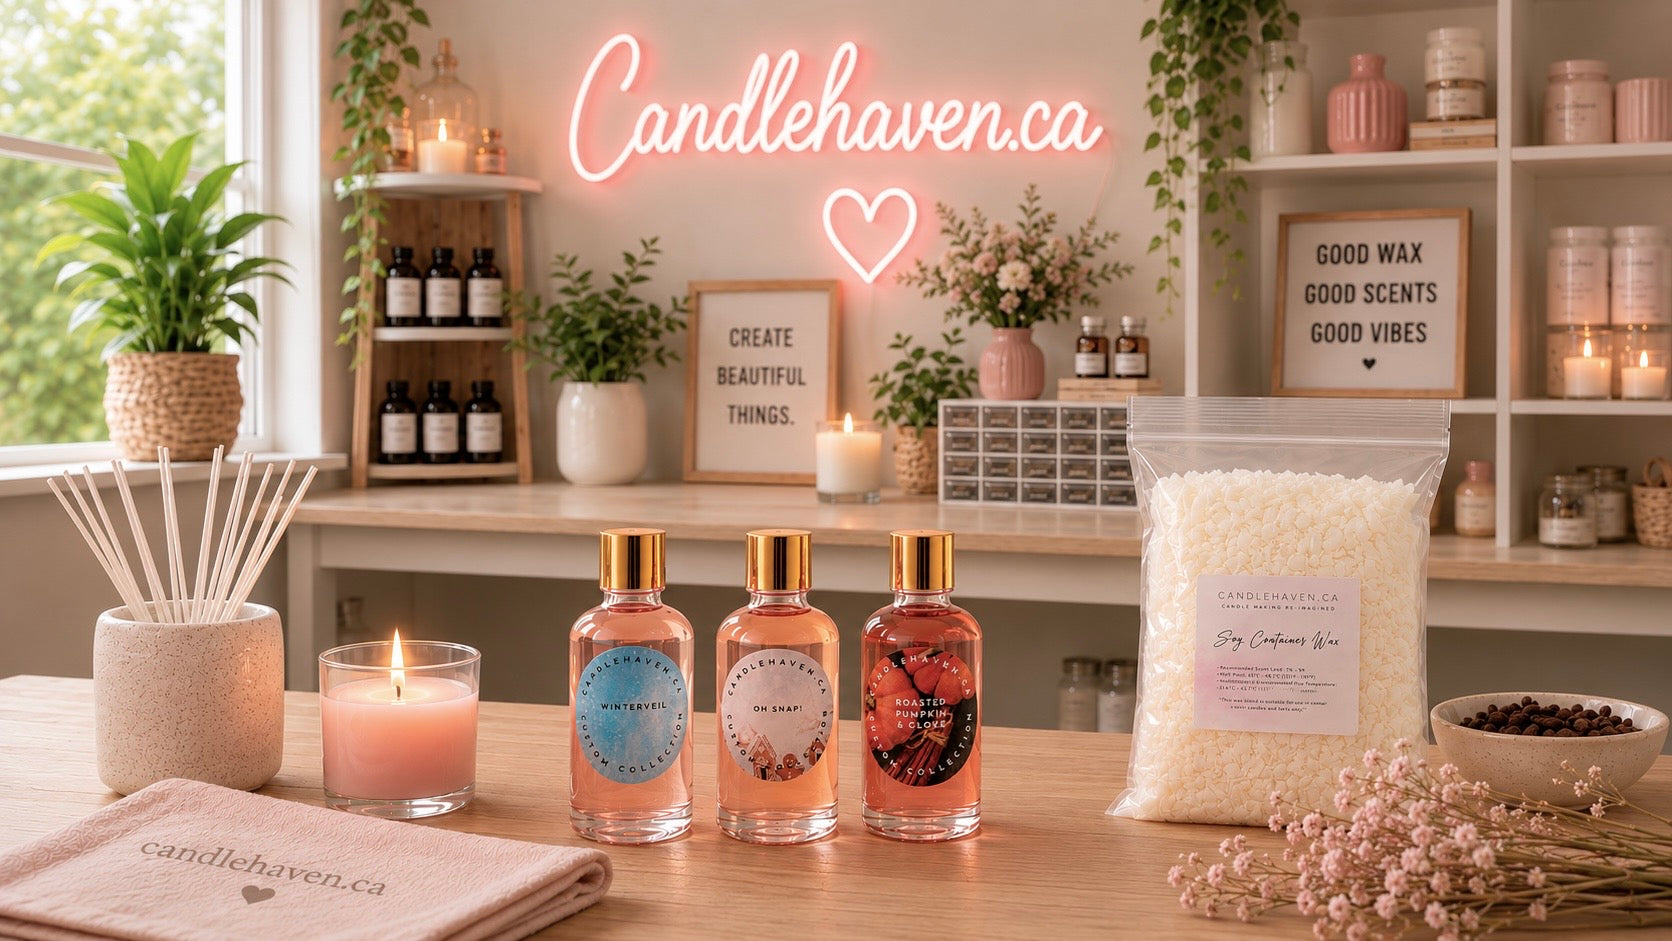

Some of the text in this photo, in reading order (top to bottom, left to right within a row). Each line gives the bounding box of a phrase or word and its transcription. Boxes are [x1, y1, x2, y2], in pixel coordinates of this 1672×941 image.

[568, 33, 1103, 182] Candlehaven.ca
[1317, 242, 1423, 265] GOOD WAX
[1304, 282, 1437, 304] GOOD SCENTS
[729, 327, 793, 347] CREATE
[1311, 322, 1427, 343] GOOD VIBES
[717, 366, 806, 386] BEAUTIFUL
[728, 405, 795, 425] THINGS.
[1217, 591, 1339, 602] CANDLEHAVEN.CA
[1213, 629, 1245, 652] Soy
[1311, 631, 1340, 650] Wax
[600, 701, 667, 711] WINTERVEIL
[895, 698, 946, 707] ROASTED
[895, 709, 947, 719] PUMPKIN
[618, 713, 683, 773] COLLECTION
[906, 713, 972, 776] COLLECTION
[140, 841, 387, 896] candlehaven.ca
